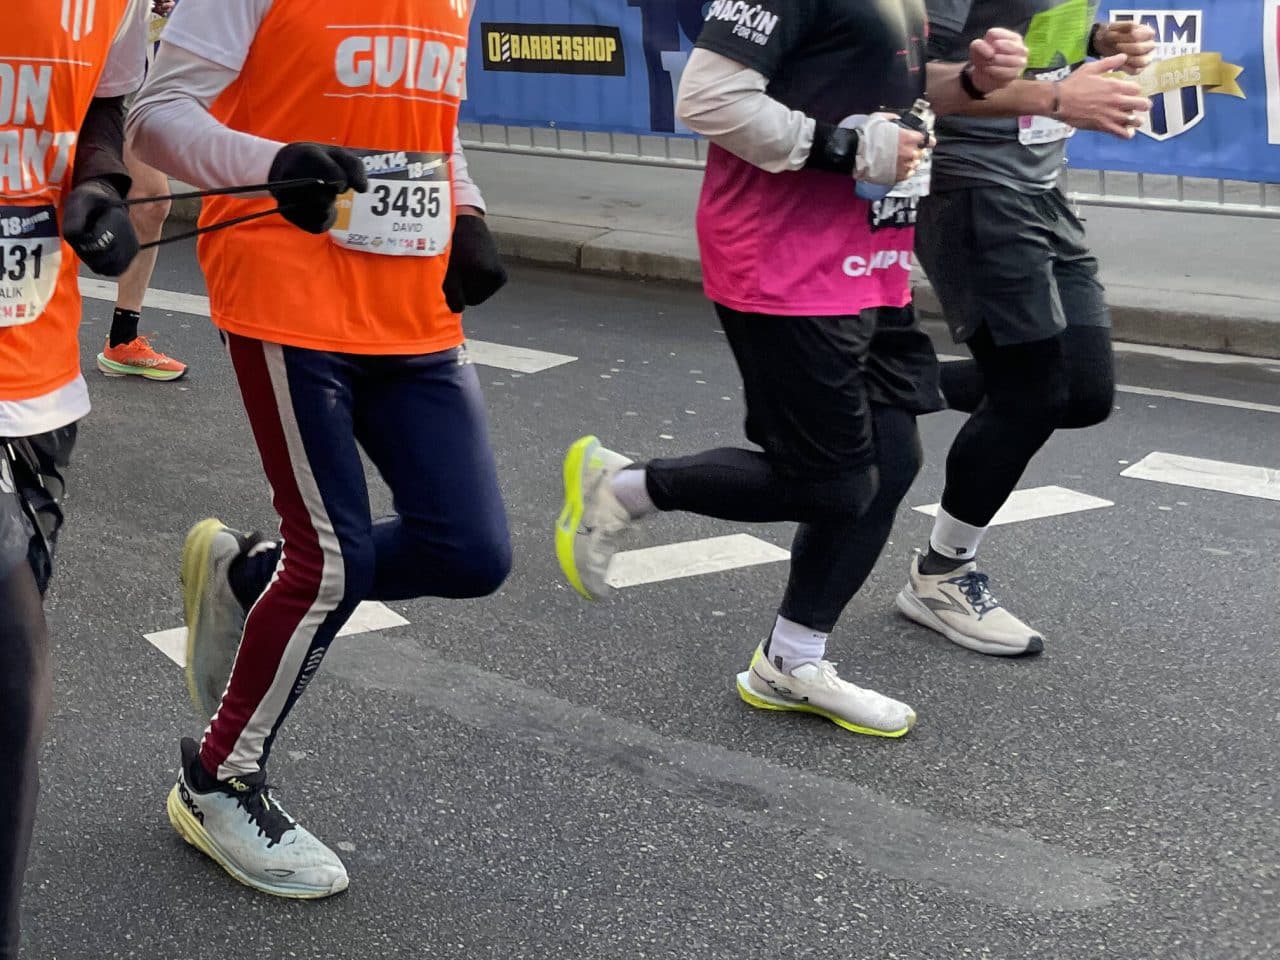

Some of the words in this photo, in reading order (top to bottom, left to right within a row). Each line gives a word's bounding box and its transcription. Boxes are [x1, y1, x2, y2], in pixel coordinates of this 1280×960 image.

[731, 23, 752, 39] FOR
[371, 184, 441, 219] 3435
[0, 216, 23, 237] 18
[392, 222, 424, 233] DAVID
